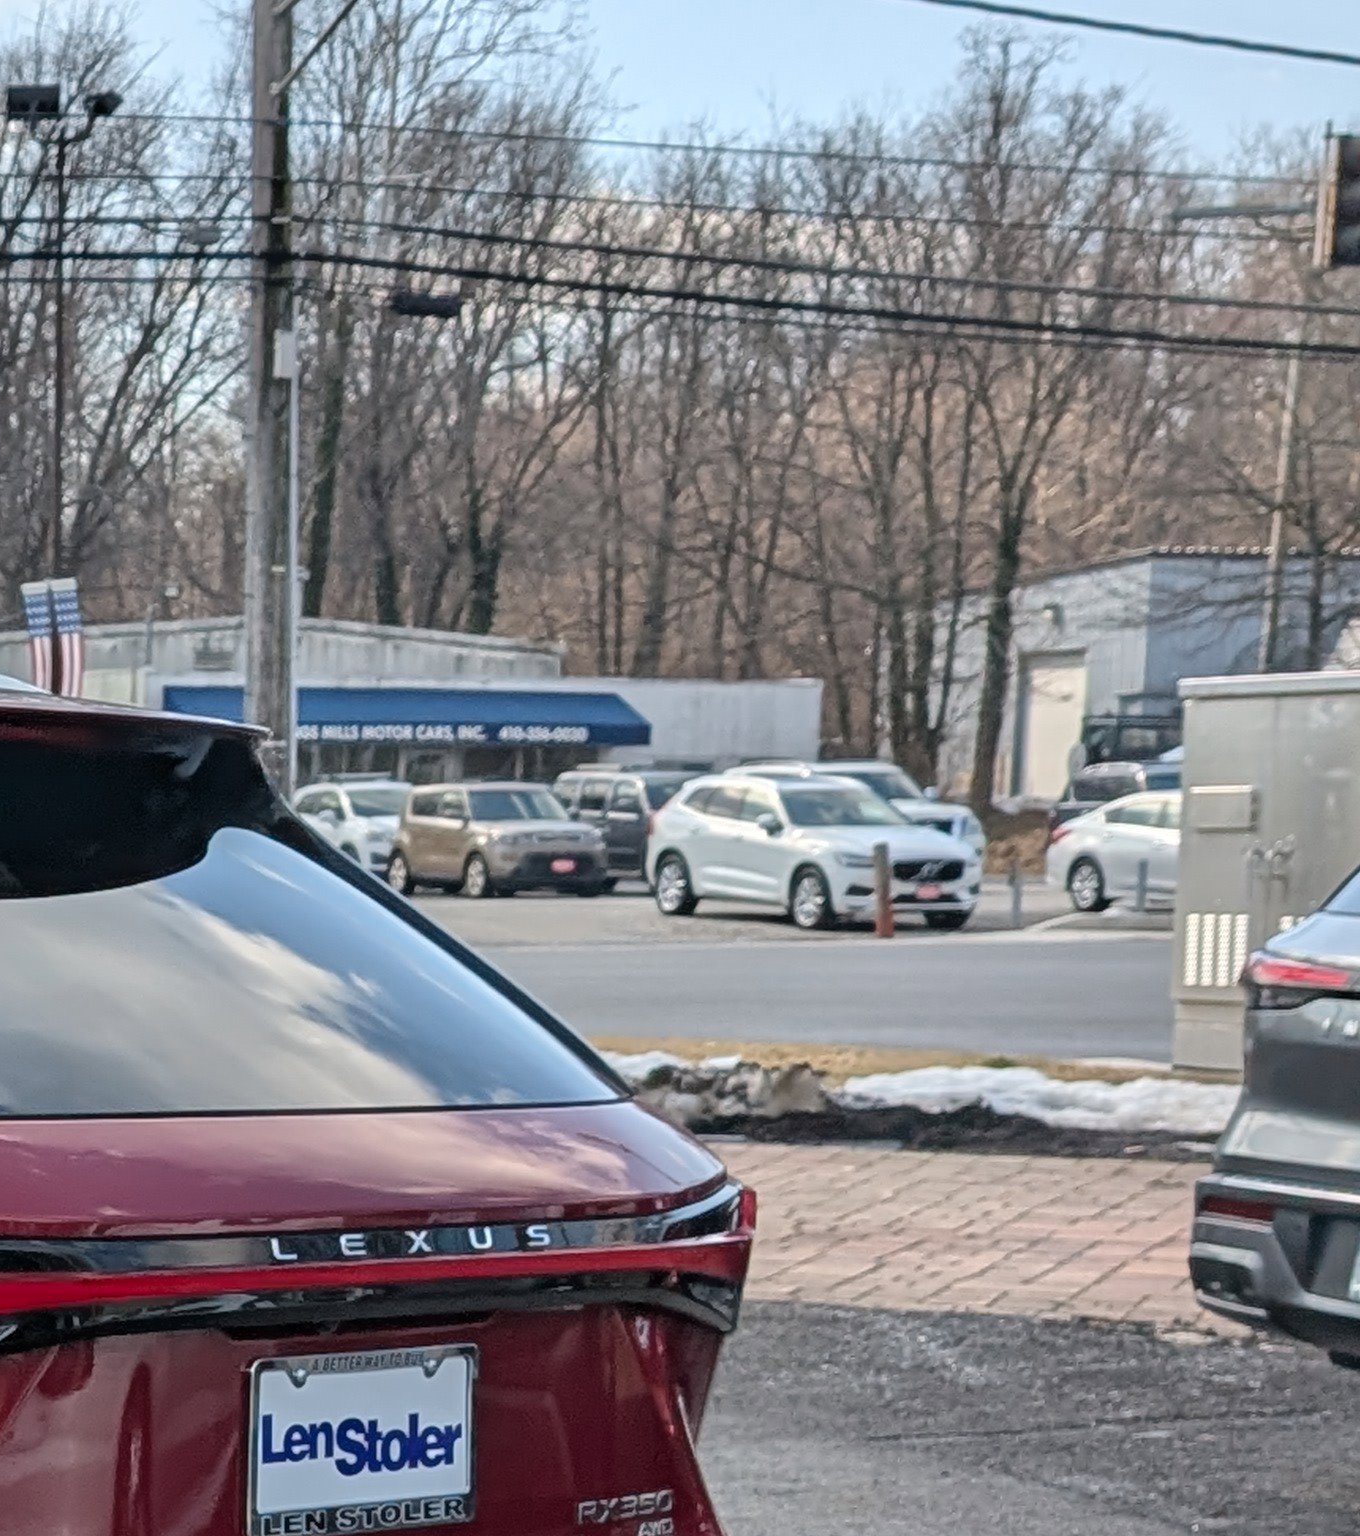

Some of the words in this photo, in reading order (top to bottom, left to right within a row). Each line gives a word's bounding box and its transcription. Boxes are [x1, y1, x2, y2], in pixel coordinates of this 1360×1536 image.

[321, 724, 359, 740] MILLS
[361, 724, 413, 740] MOTOR
[270, 1224, 550, 1260] LEXUS
[322, 1356, 361, 1371] BETTER
[336, 1498, 466, 1529] STOLER
